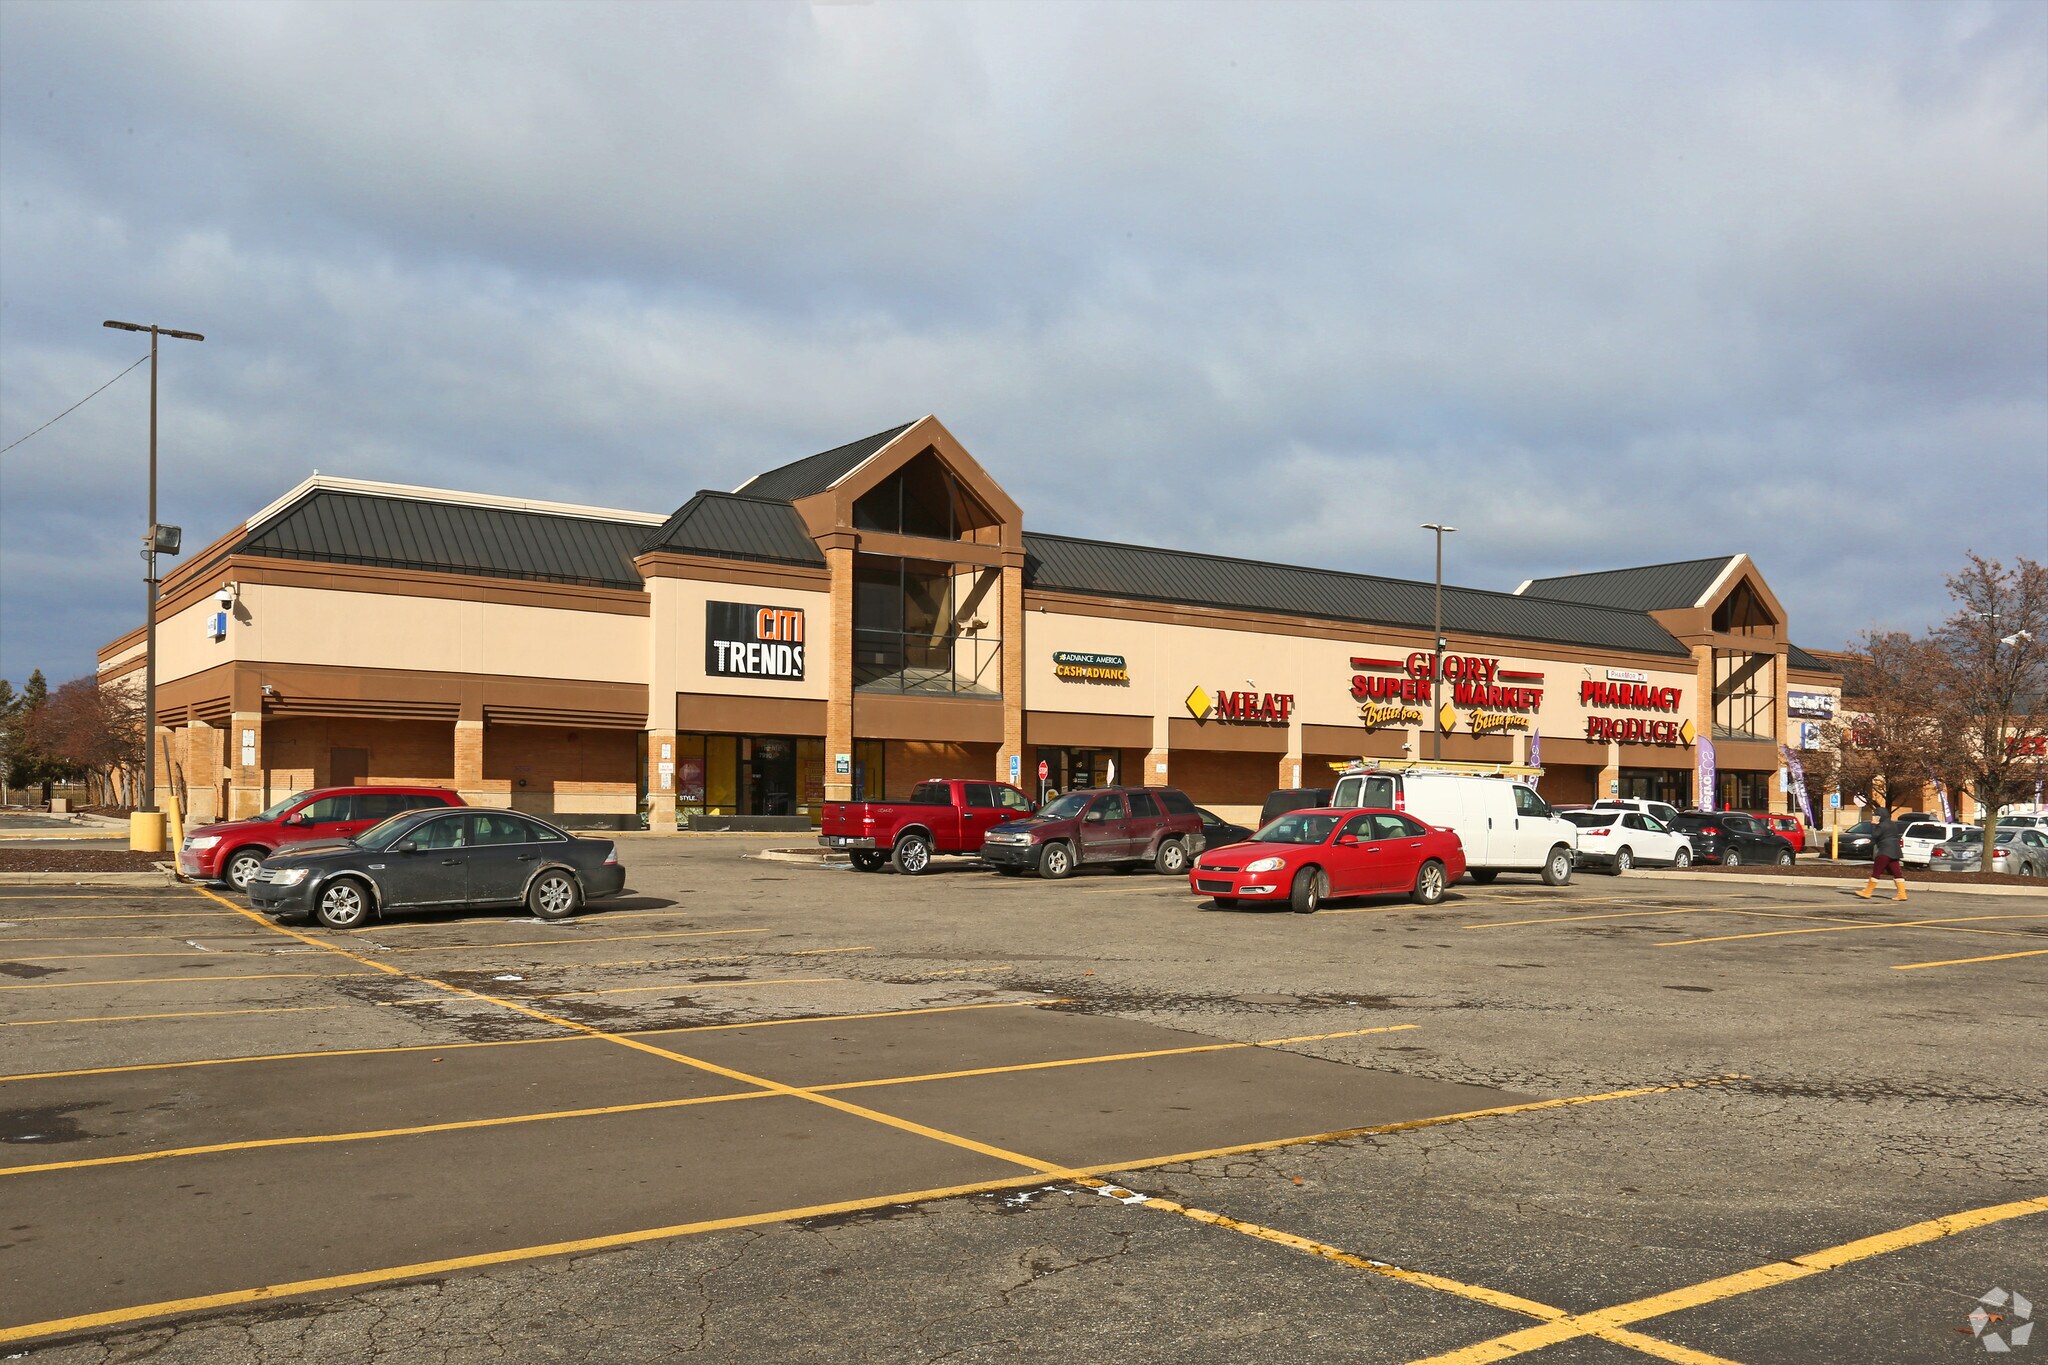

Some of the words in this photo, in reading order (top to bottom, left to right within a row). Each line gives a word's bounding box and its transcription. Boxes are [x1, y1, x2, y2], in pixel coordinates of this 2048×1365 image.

[757, 607, 803, 642] CITI
[713, 640, 802, 677] TRENDS
[1066, 654, 1094, 663] ADVANCE
[1096, 656, 1123, 665] AMERICA
[1057, 665, 1083, 677] CASH
[1086, 668, 1128, 680] ADVANCE
[1217, 690, 1294, 720] MEAT
[1352, 675, 1432, 701] SUPER
[1454, 682, 1544, 709] MARKET
[1581, 680, 1682, 709] PHARMACY
[1361, 702, 1399, 727] Better
[1401, 706, 1424, 721] food
[1469, 709, 1503, 733] Better
[1505, 715, 1530, 729] prices
[1587, 716, 1678, 742] PRODUCE
